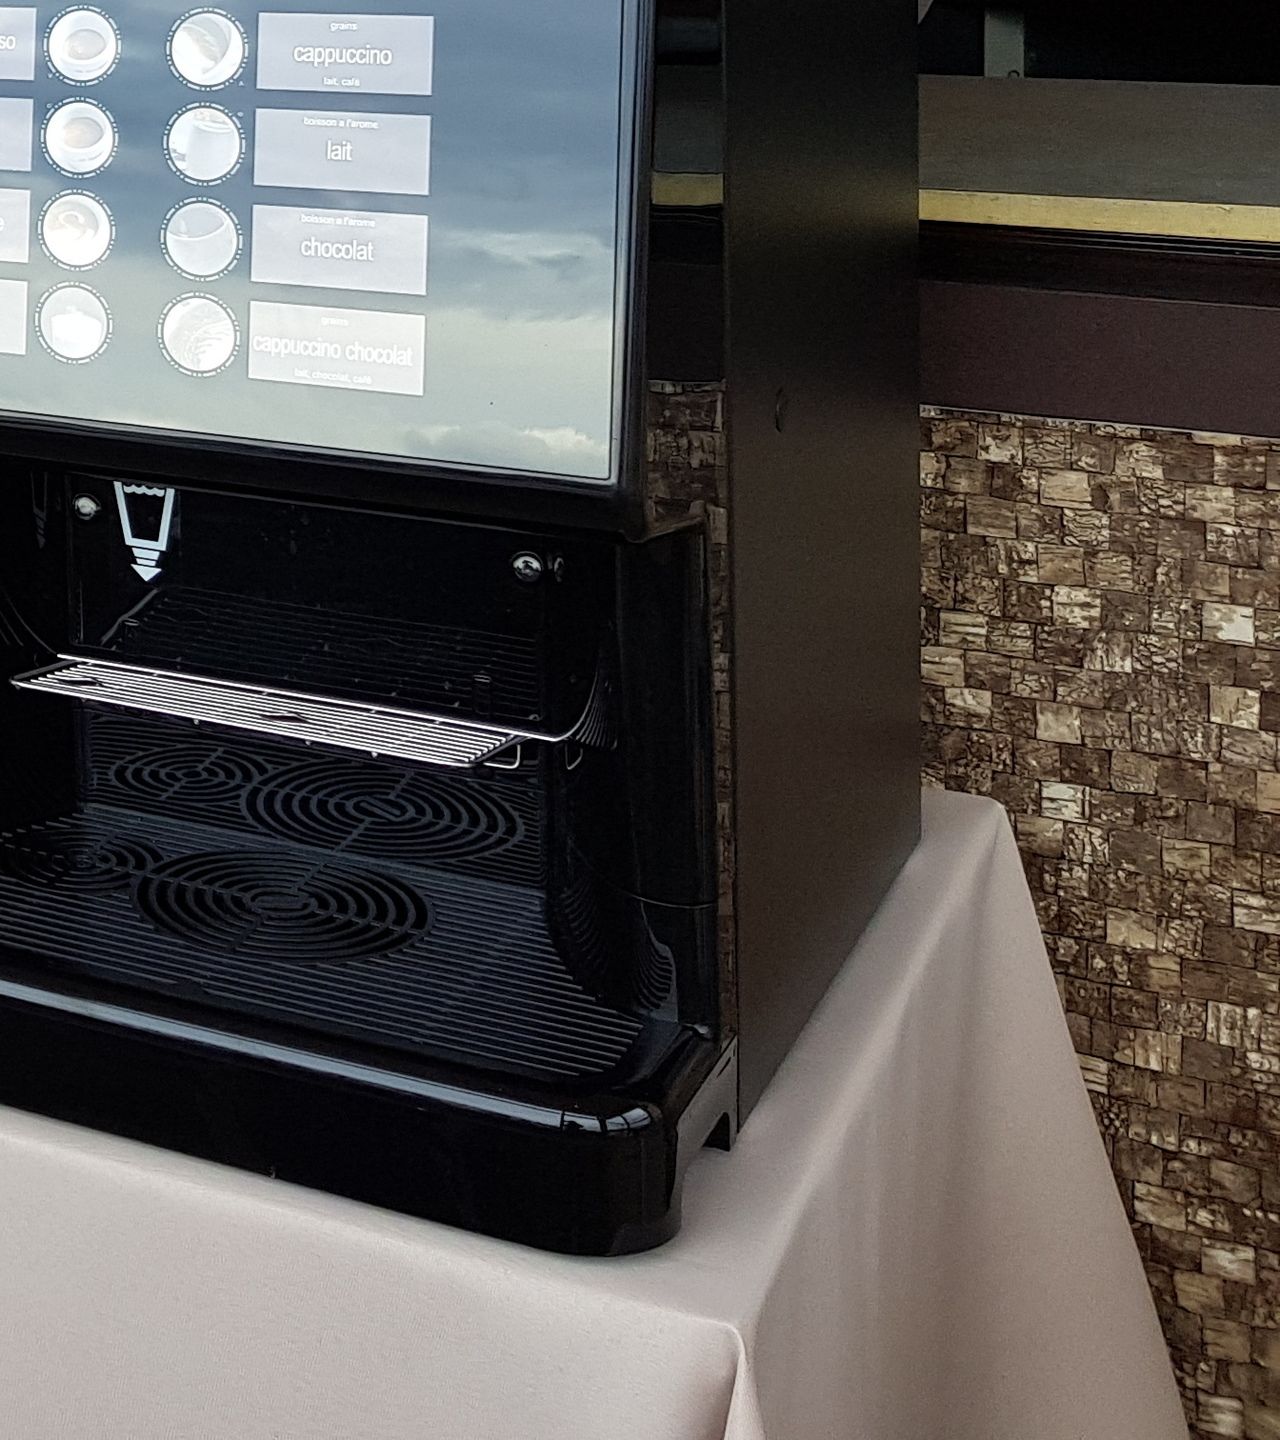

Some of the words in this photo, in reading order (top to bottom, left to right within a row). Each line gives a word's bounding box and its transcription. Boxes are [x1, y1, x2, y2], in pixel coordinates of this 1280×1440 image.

[293, 44, 393, 68] cappuccino
[327, 140, 353, 161] lait
[300, 213, 336, 225] boisson
[301, 236, 374, 261] chocolat
[252, 335, 341, 359] cappuccino
[345, 340, 413, 367] chocolat
